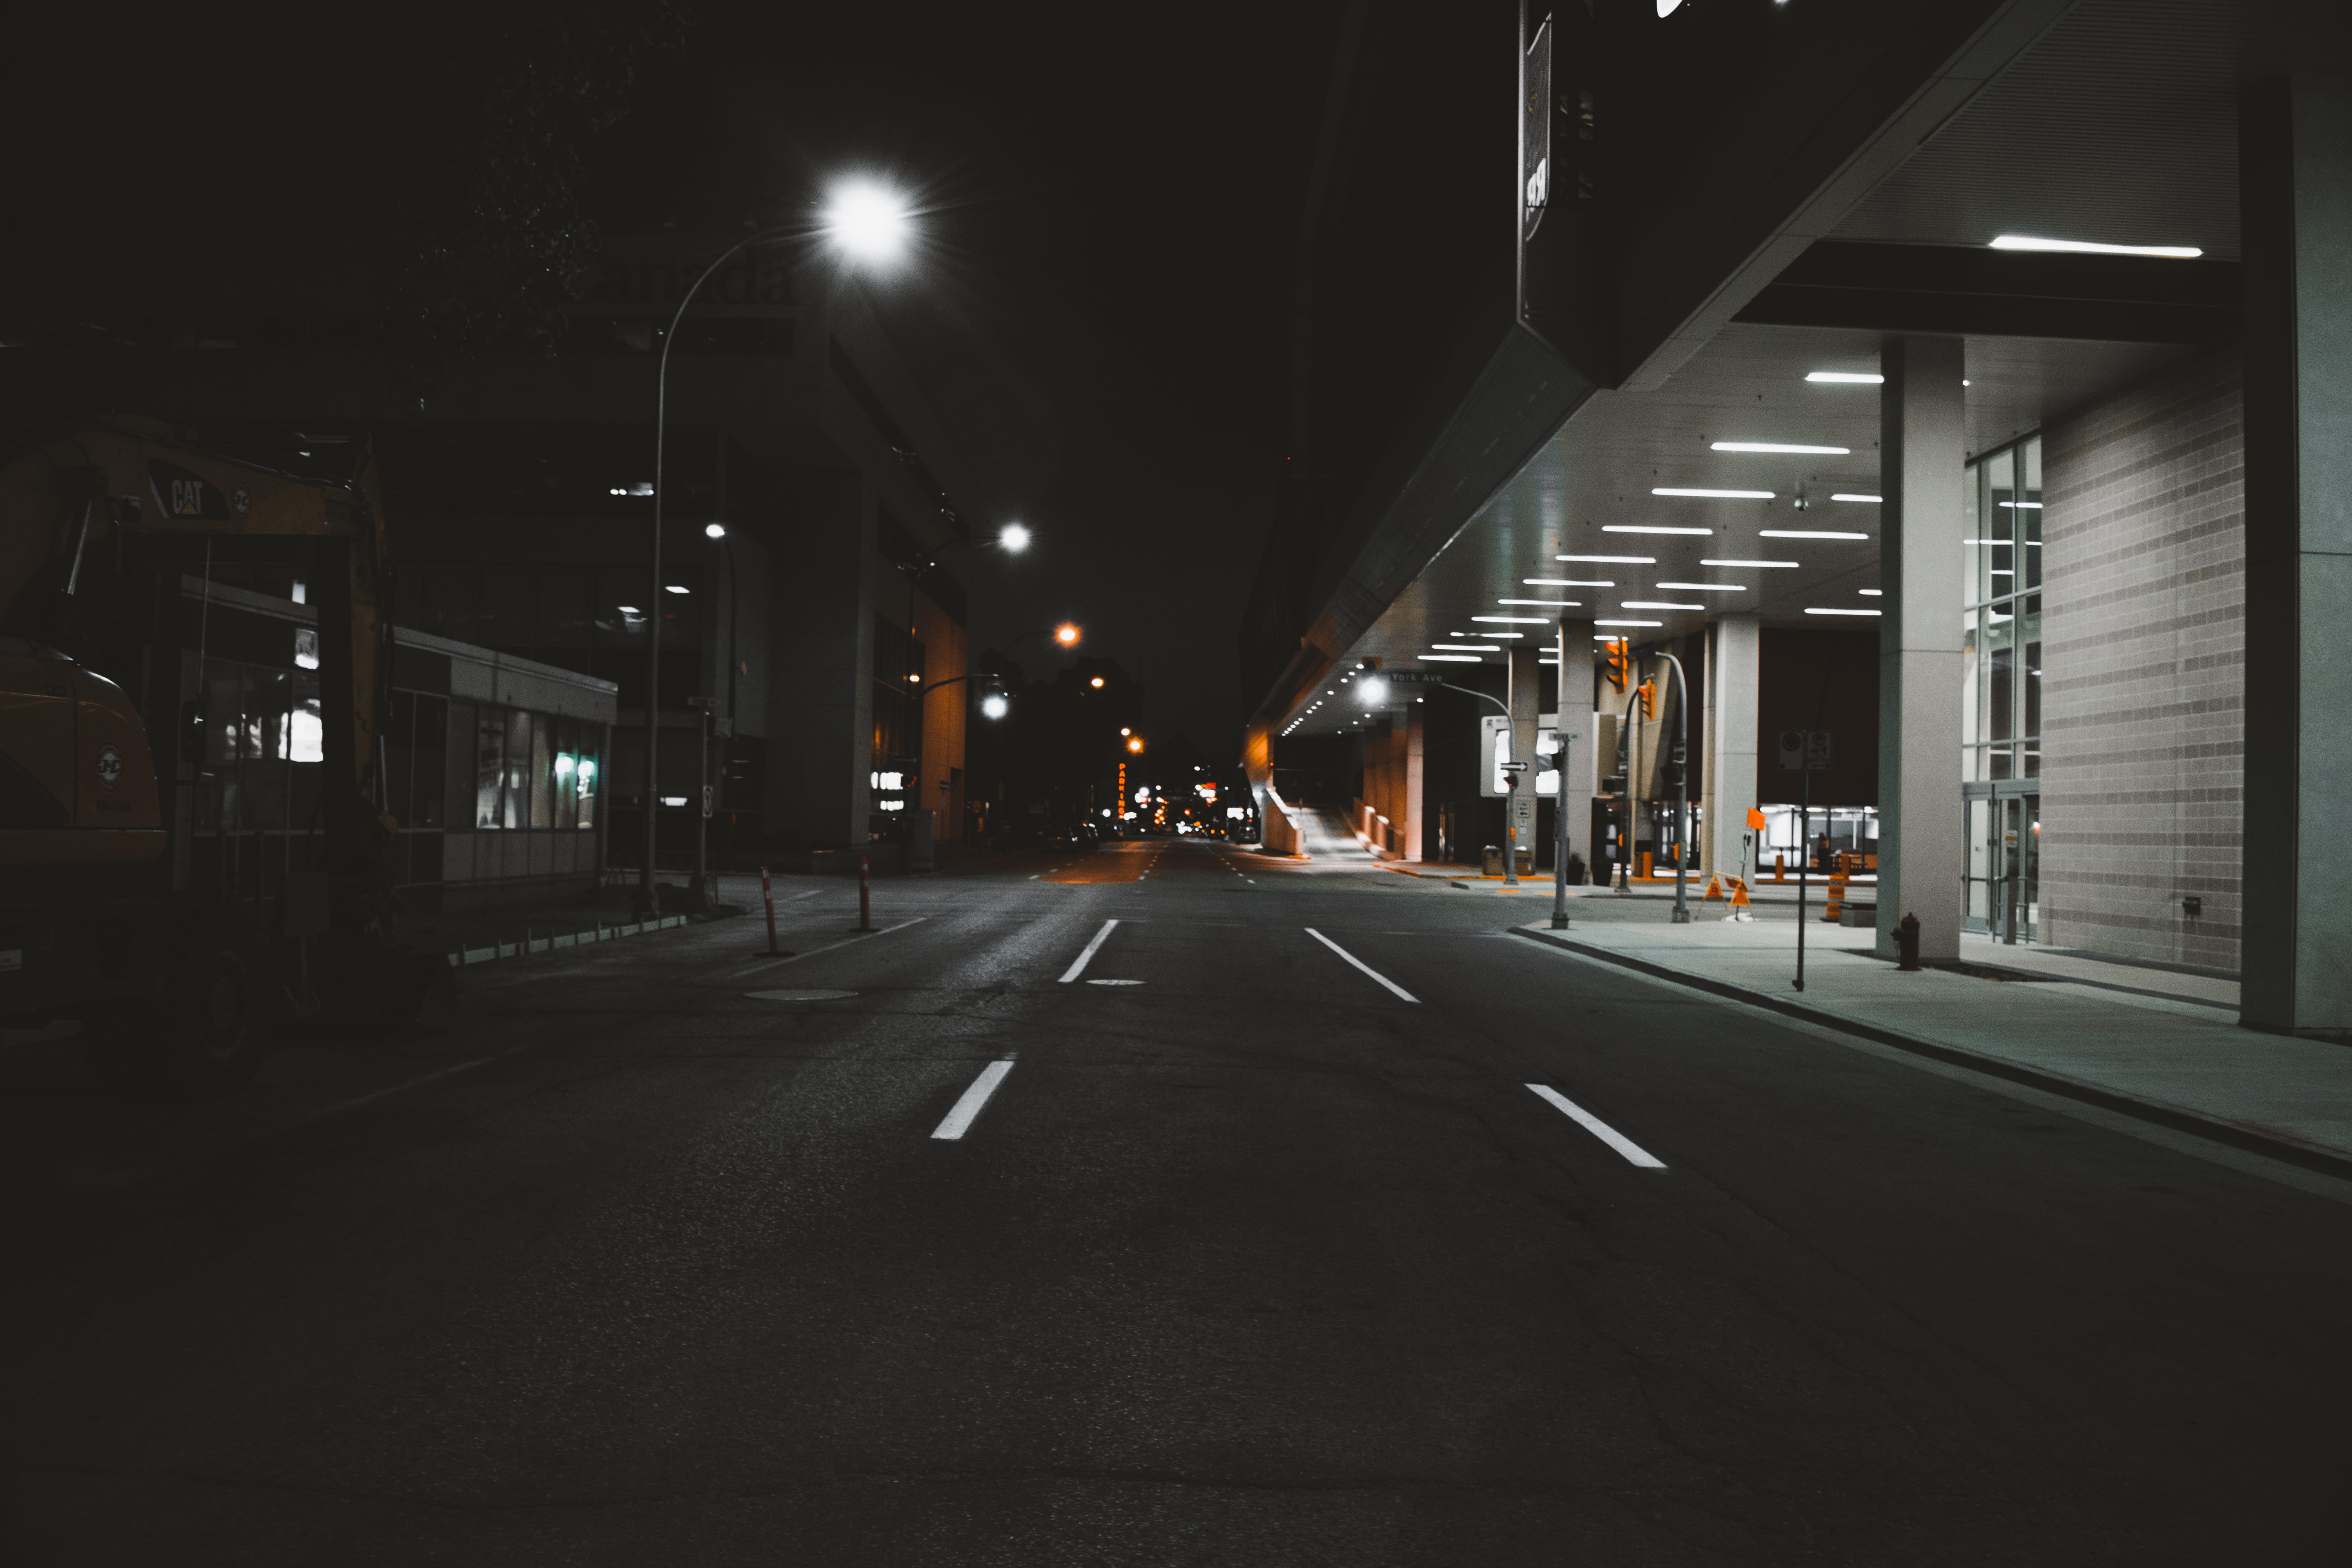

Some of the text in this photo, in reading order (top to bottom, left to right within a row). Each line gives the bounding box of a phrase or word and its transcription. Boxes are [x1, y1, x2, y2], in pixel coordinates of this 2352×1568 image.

[589, 243, 800, 304] anada
[172, 479, 203, 514] CAT
[1392, 673, 1416, 681] York
[1118, 763, 1126, 815] PARKING
